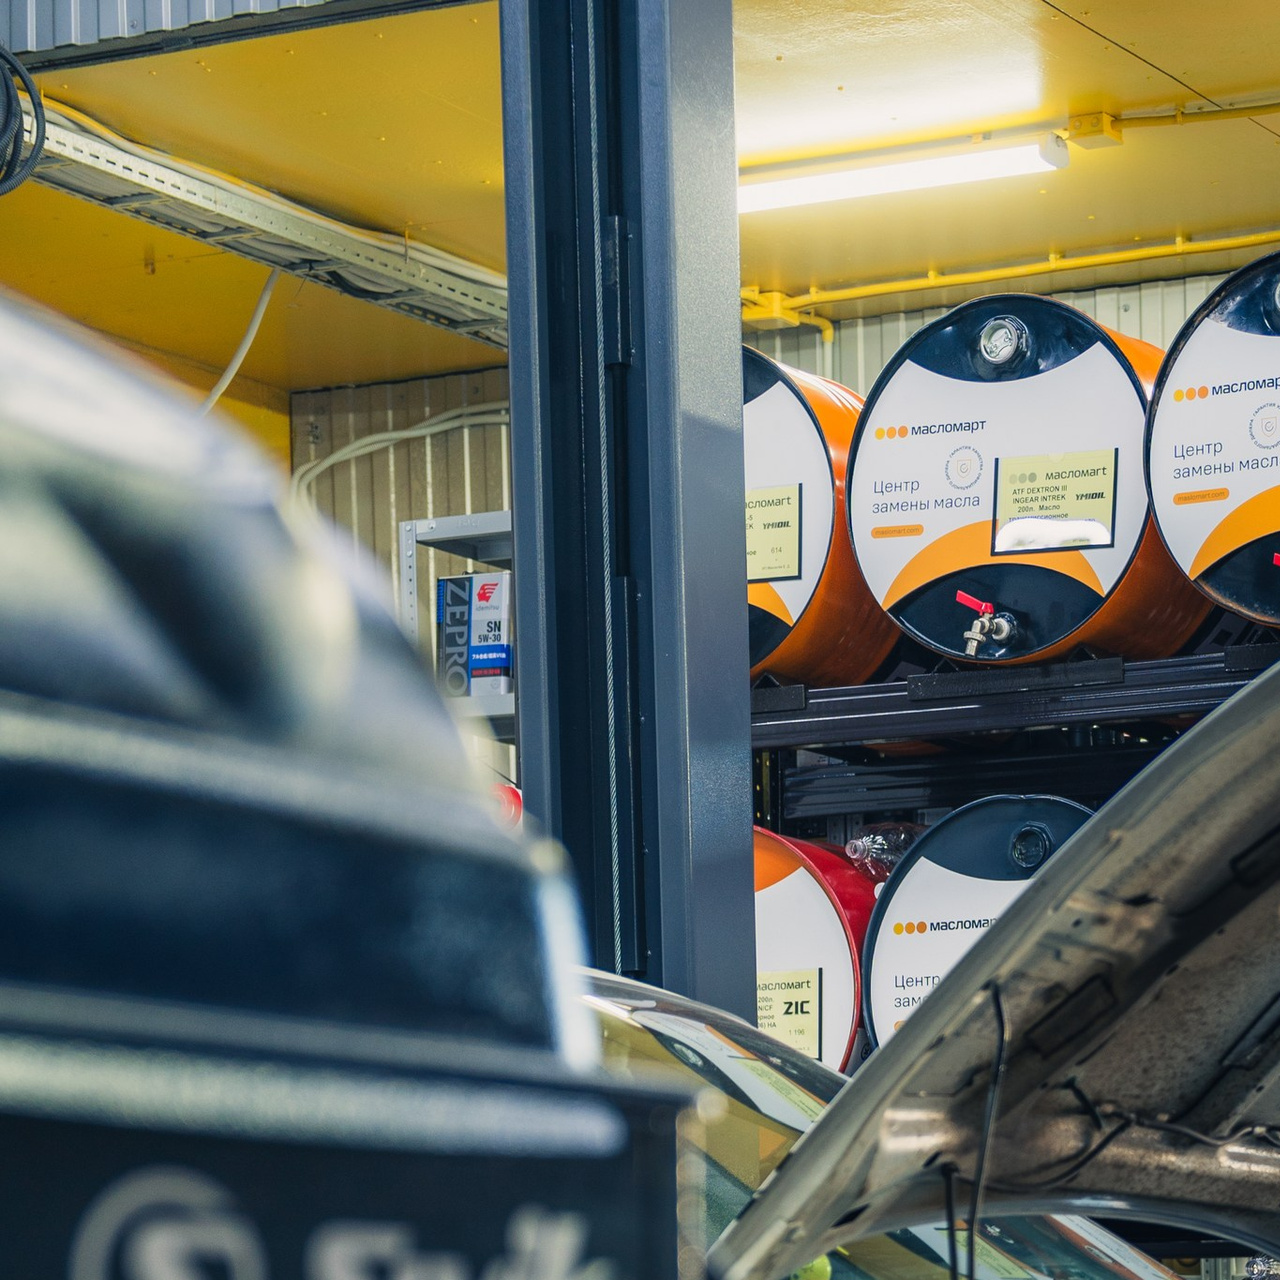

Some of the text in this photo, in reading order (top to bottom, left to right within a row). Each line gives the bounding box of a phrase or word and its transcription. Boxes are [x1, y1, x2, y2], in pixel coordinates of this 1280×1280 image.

[911, 420, 986, 435] масломарт
[1174, 442, 1223, 460] Центр
[1173, 462, 1234, 479] замены
[873, 480, 920, 495] Центр
[1012, 488, 1025, 496] ATF
[1027, 486, 1060, 494] DEXTRON
[872, 495, 980, 514] замены масла
[1012, 494, 1066, 504] INGEAR INTREK
[486, 620, 501, 632] SN
[446, 580, 469, 696] ZEPRO
[478, 633, 501, 643] 5W-30
[783, 1000, 810, 1015] ZIC
